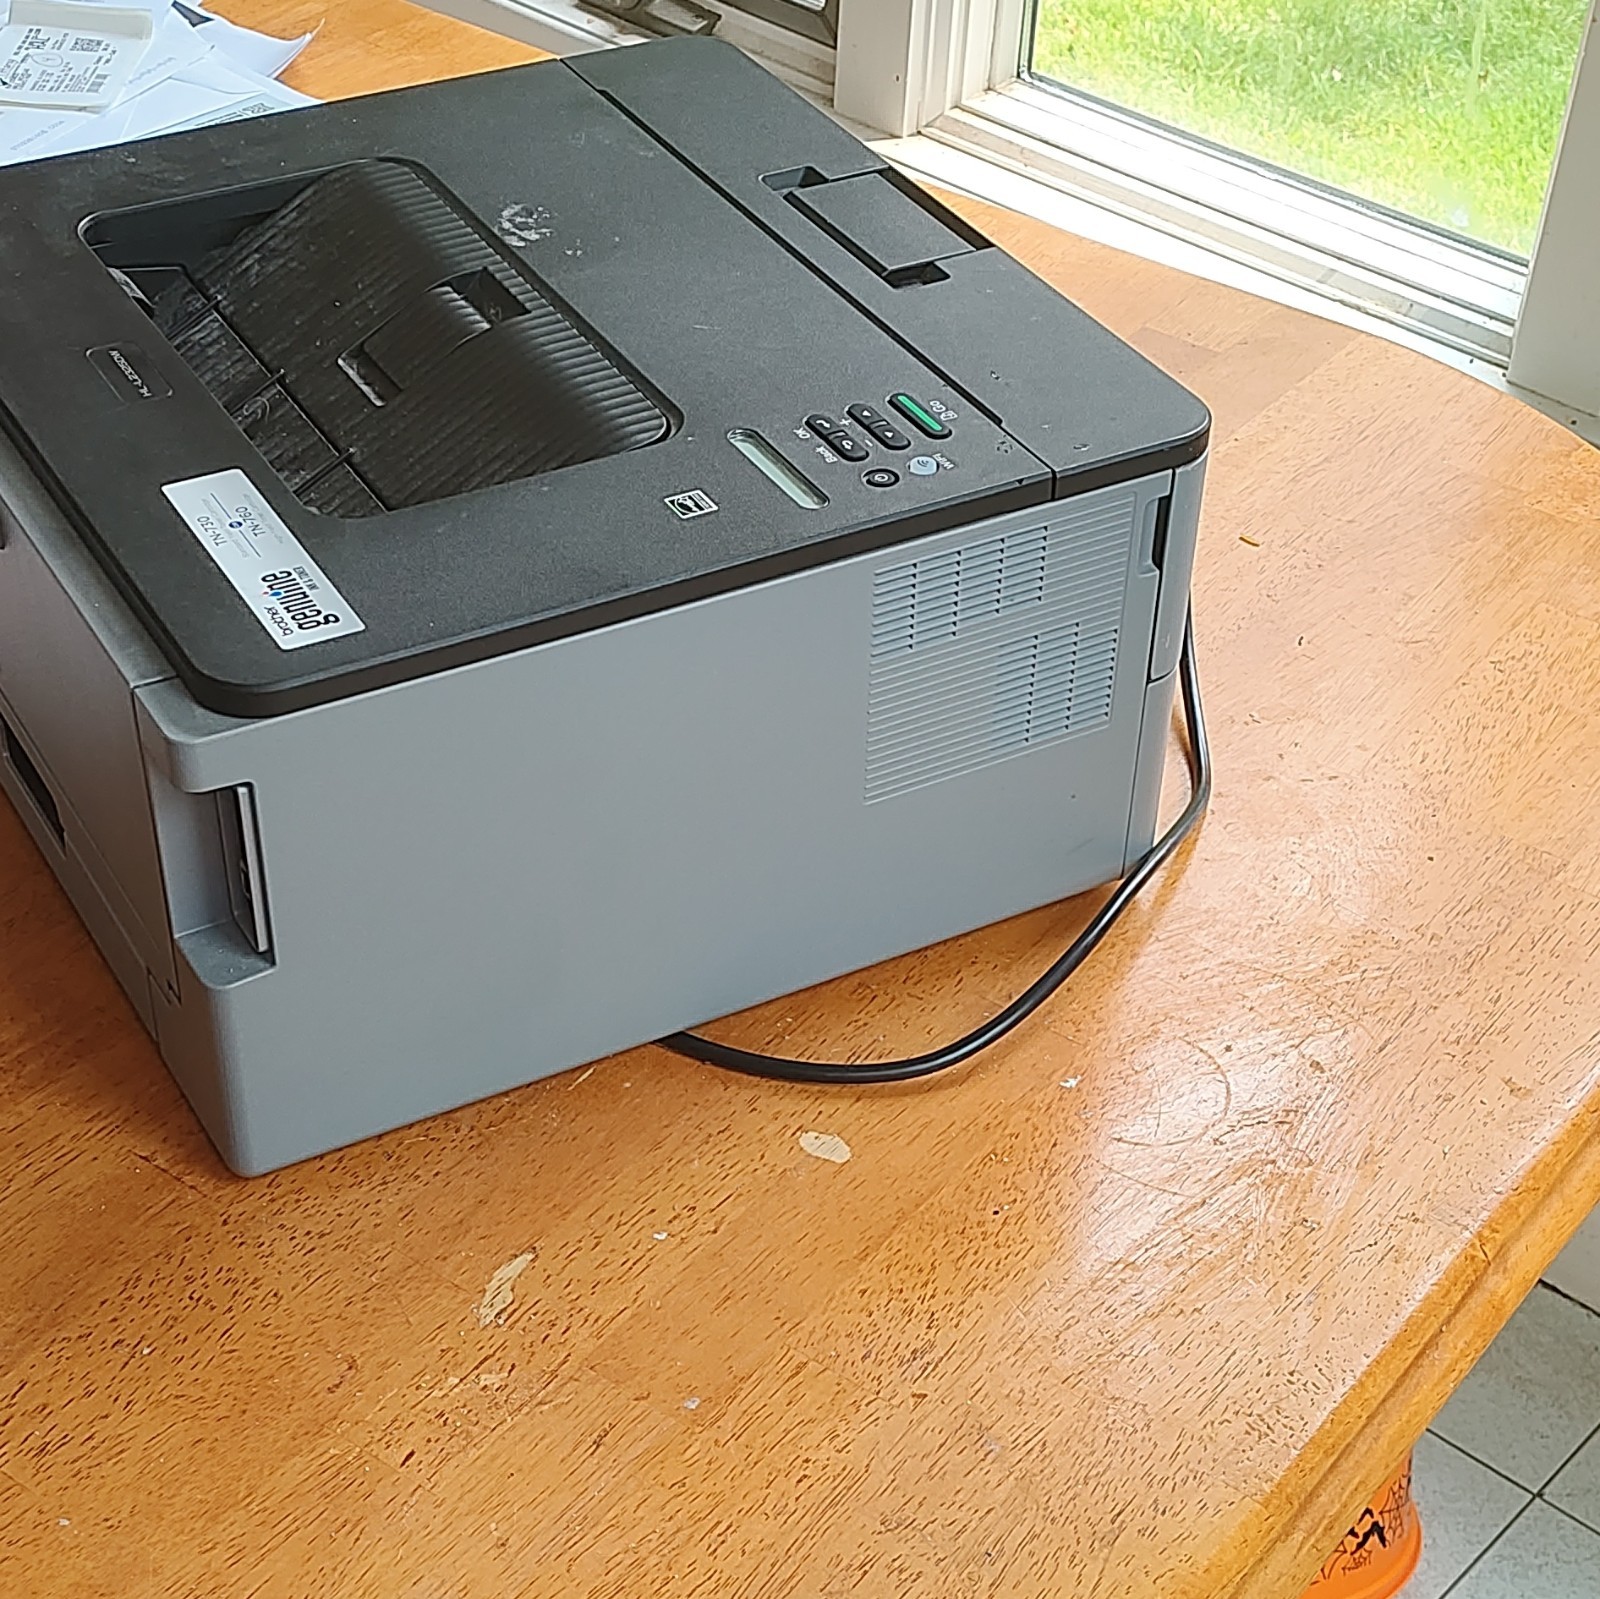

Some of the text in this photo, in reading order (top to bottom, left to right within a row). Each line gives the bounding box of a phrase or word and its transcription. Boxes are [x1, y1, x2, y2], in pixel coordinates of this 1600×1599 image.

[930, 400, 945, 412] Go
[793, 427, 811, 439] OK
[816, 446, 838, 463] Back
[197, 516, 227, 546] TN-730
[235, 506, 266, 537] TN-760
[261, 570, 340, 630] genuine
[263, 606, 294, 637] brother
